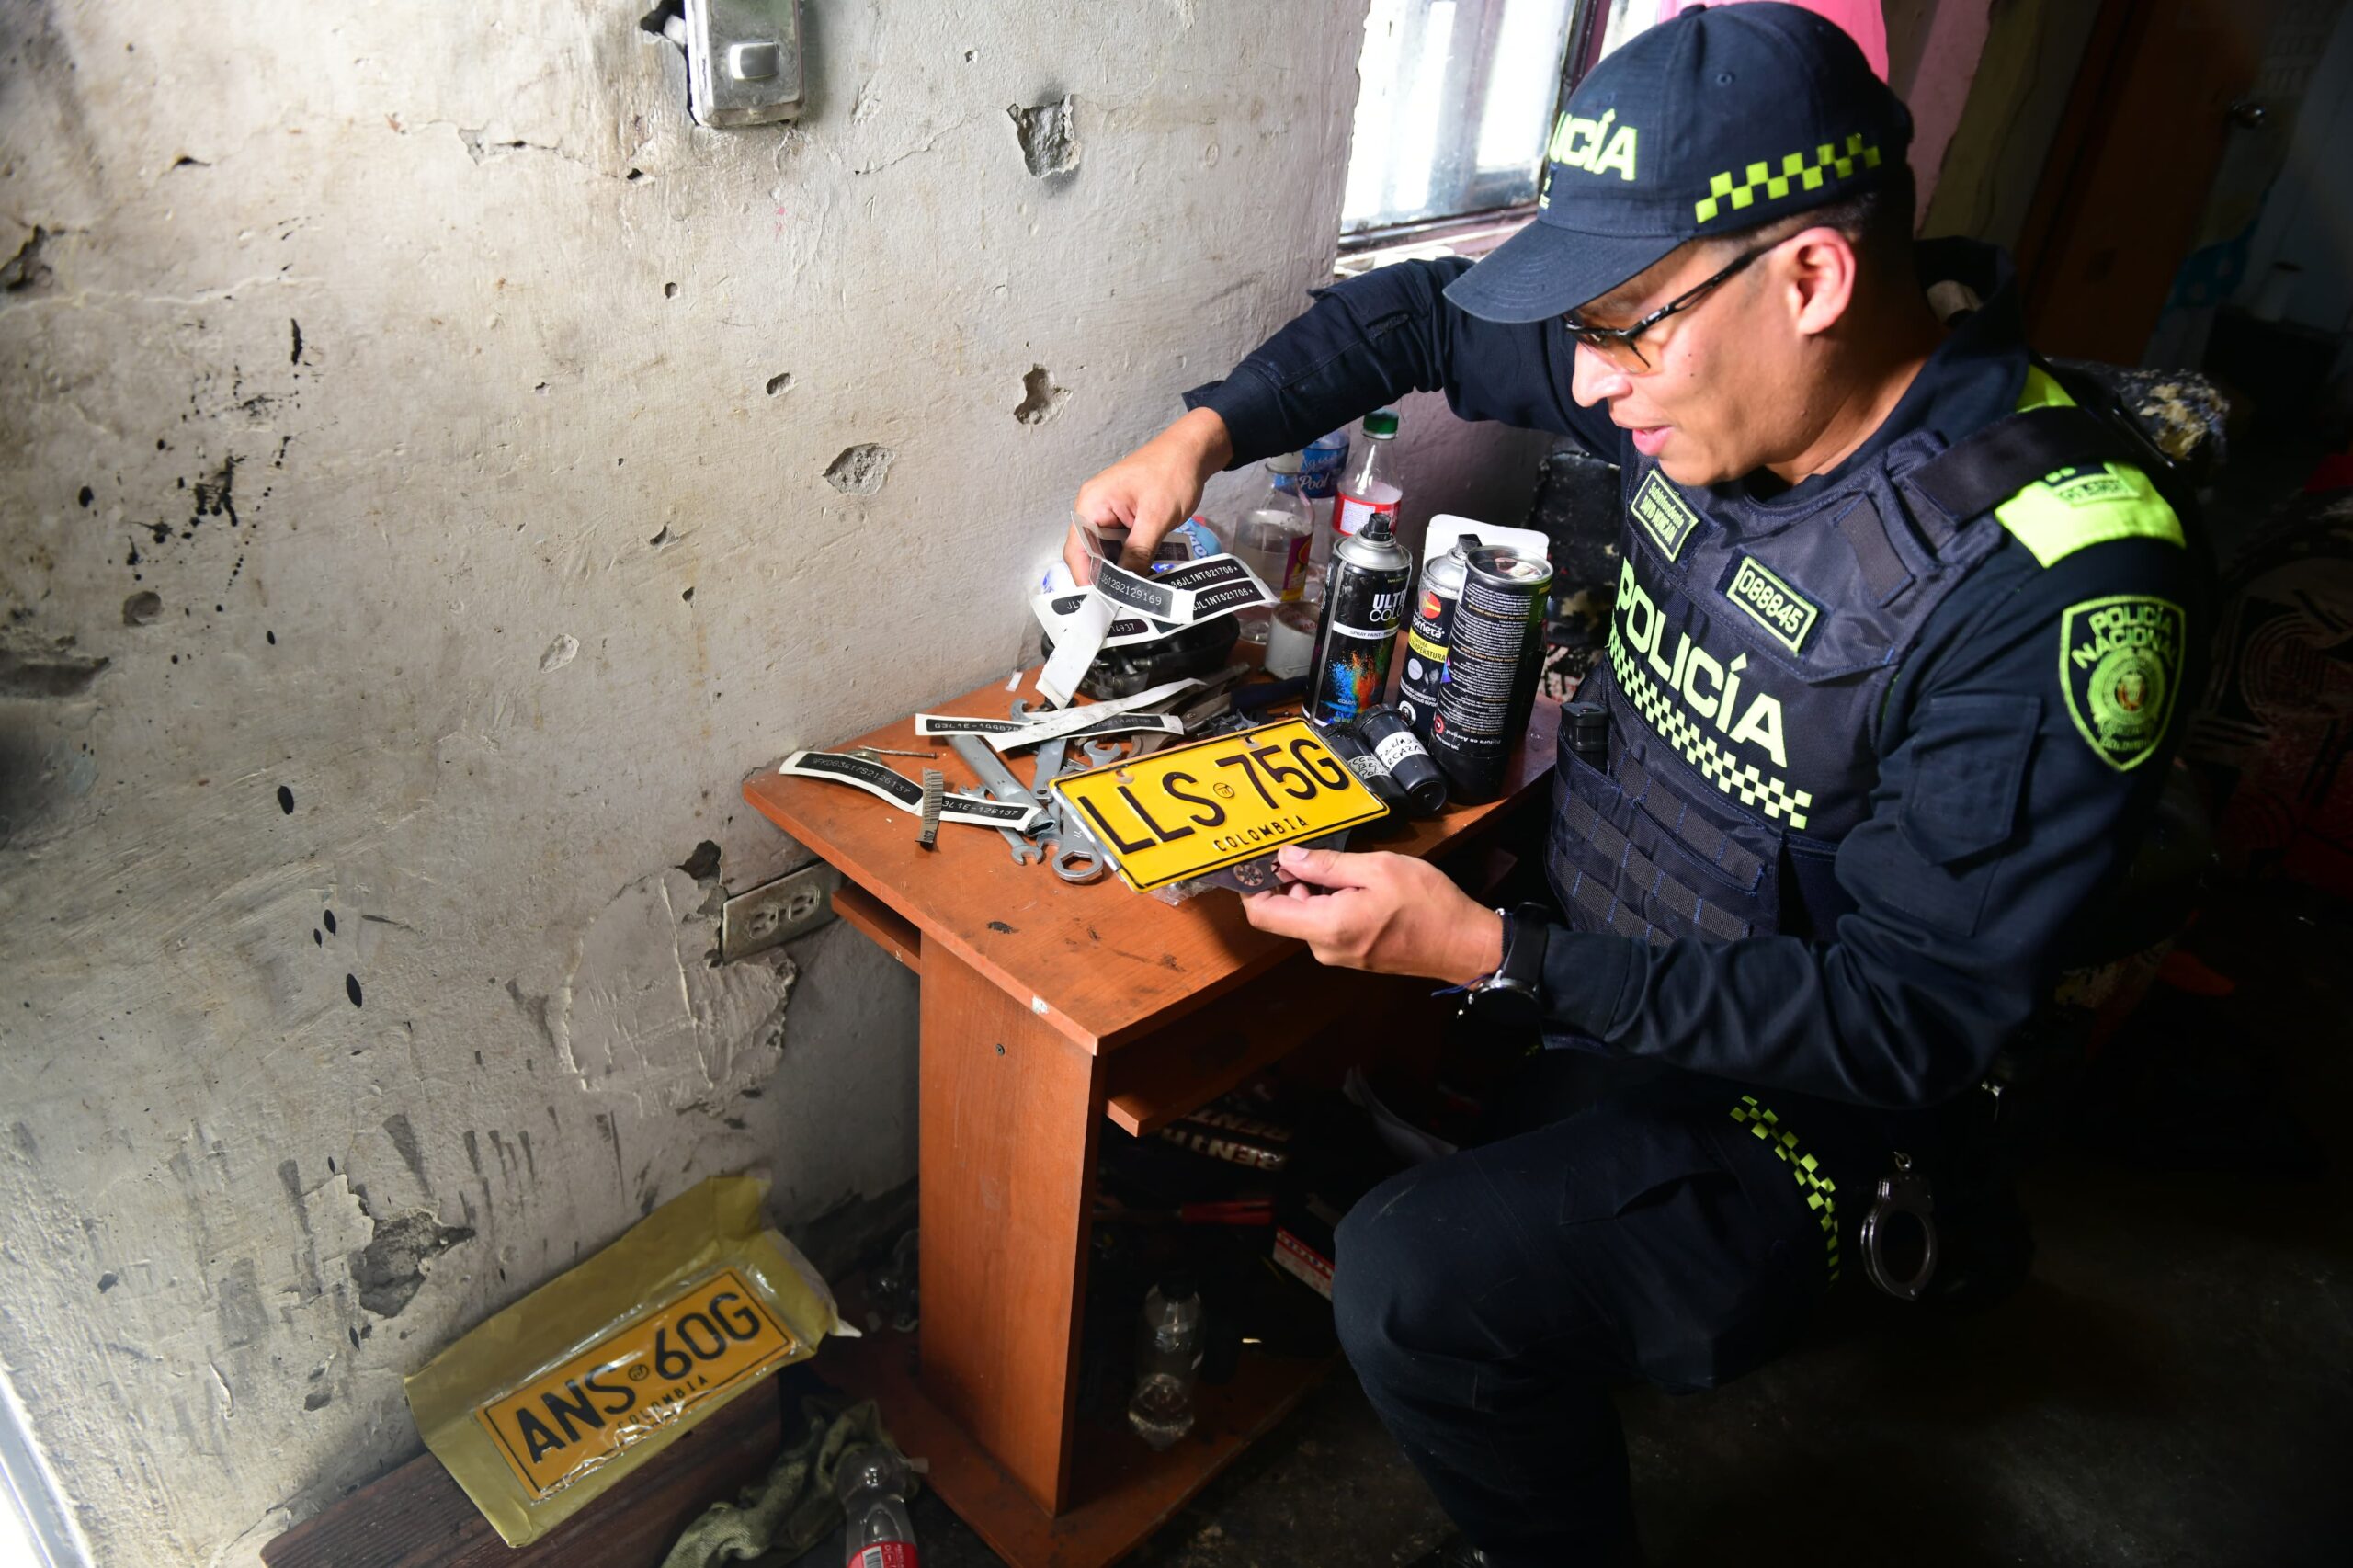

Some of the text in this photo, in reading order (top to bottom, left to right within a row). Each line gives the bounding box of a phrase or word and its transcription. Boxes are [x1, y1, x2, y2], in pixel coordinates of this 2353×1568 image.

[1737, 569, 1804, 634] 088845
[2088, 606, 2172, 635] POLICÍA
[1616, 556, 1788, 768] POLICÍA
[1076, 738, 1350, 855] LLS 75G
[1213, 814, 1309, 853] COLOMBIA
[516, 1291, 761, 1464] ANS 60G
